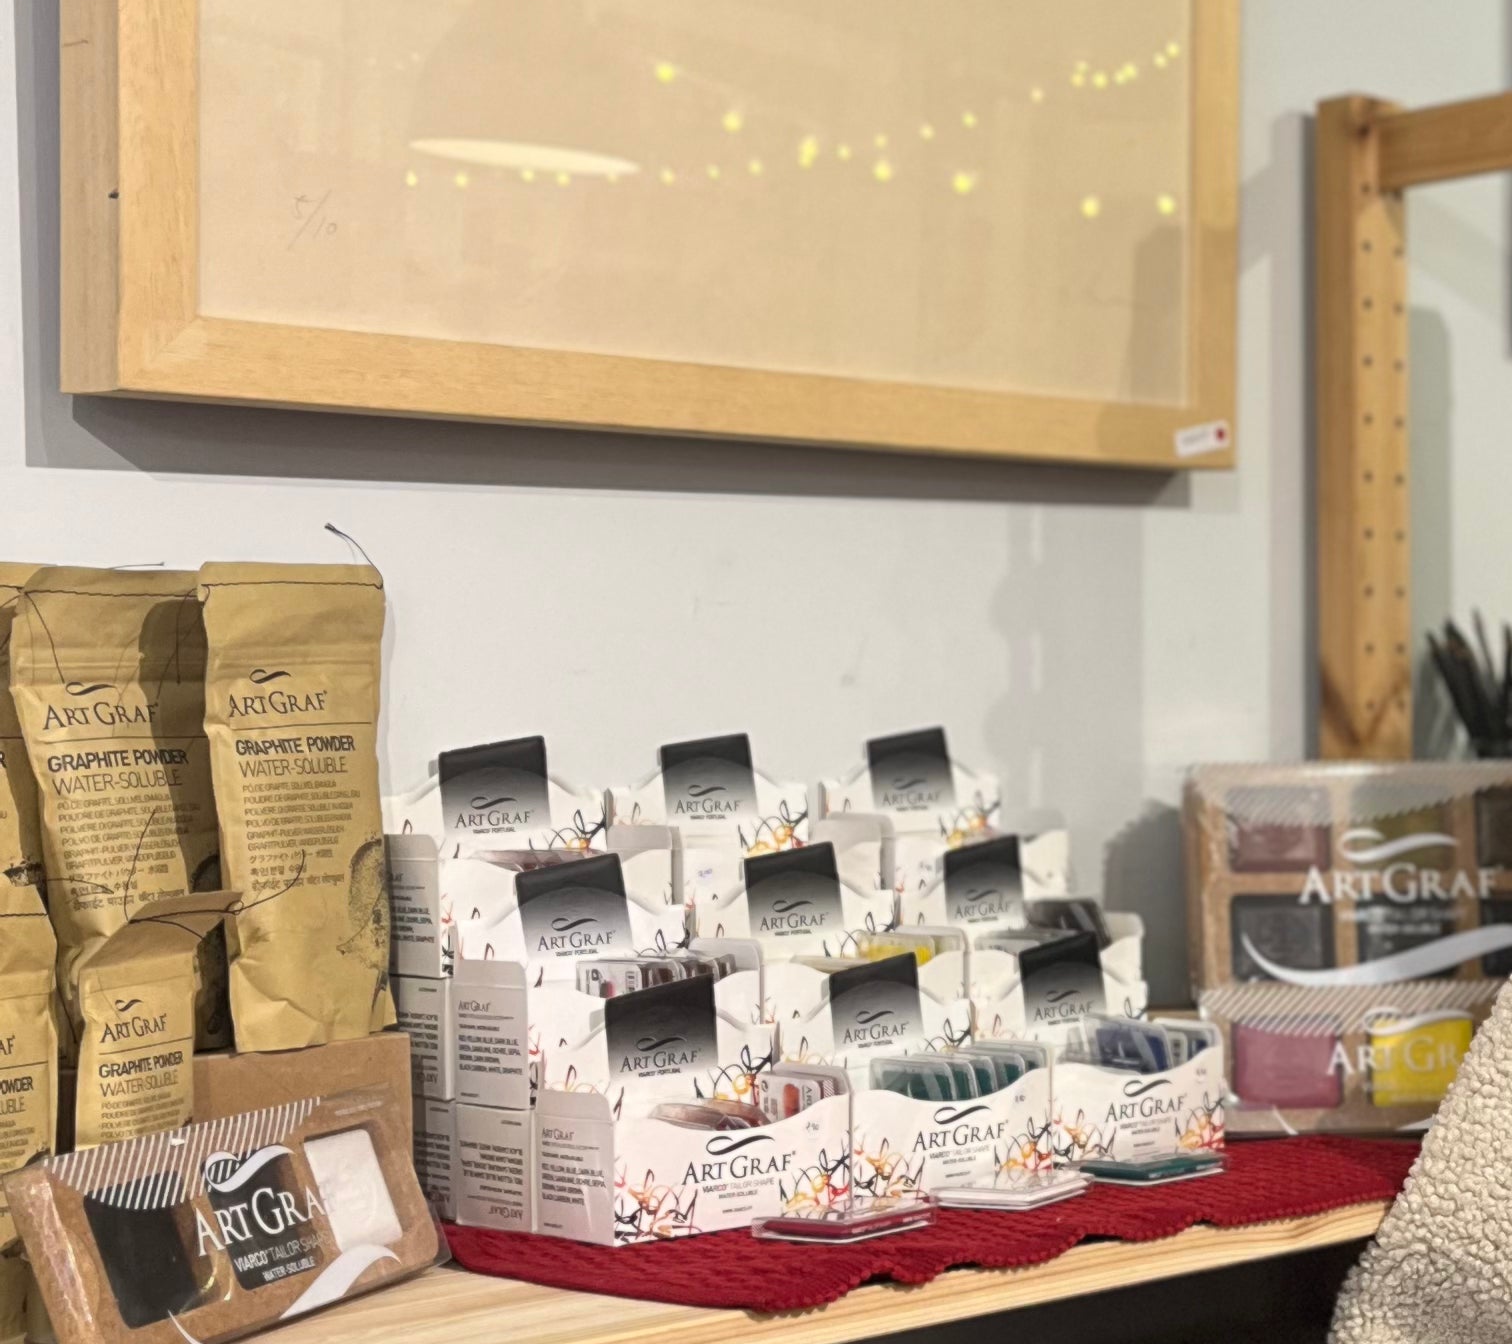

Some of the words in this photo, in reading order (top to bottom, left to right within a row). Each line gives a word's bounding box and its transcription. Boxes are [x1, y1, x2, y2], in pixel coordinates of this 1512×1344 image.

[236, 737, 303, 756] GRAPHITE
[307, 735, 356, 753] POWDER
[47, 749, 131, 773] GRAPHITE
[133, 748, 190, 766] POWDER
[238, 757, 348, 778] WATER-SOLUBLE
[52, 768, 183, 797] WATER-SOLUBLE
[98, 1057, 153, 1079] GRAPHITE
[153, 1051, 184, 1070] POWDER
[233, 1250, 269, 1273] VIARCO
